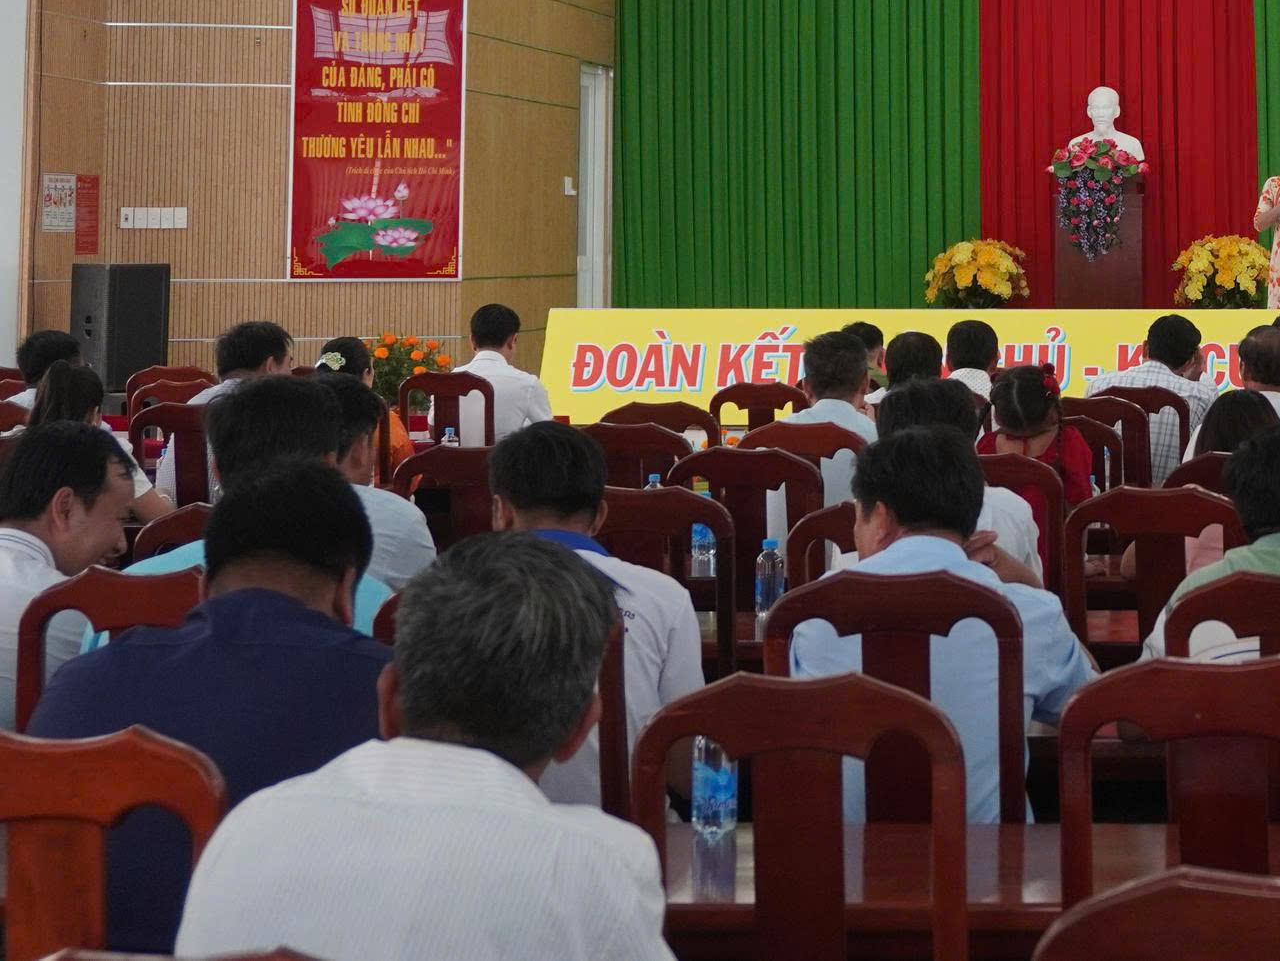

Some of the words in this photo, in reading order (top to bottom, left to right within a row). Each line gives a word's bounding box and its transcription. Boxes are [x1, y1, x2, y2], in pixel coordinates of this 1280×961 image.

[322, 60, 346, 88] CỦA
[389, 63, 416, 88] PHẢI
[419, 64, 436, 88] CÓ
[337, 97, 363, 123] TÌNH
[401, 98, 421, 124] CHÍ
[302, 134, 346, 158] THƯƠNG
[350, 133, 374, 158] YÊU
[377, 129, 401, 158] LẪN
[571, 329, 706, 392] ĐOÀN
[716, 325, 807, 388] KẾT
